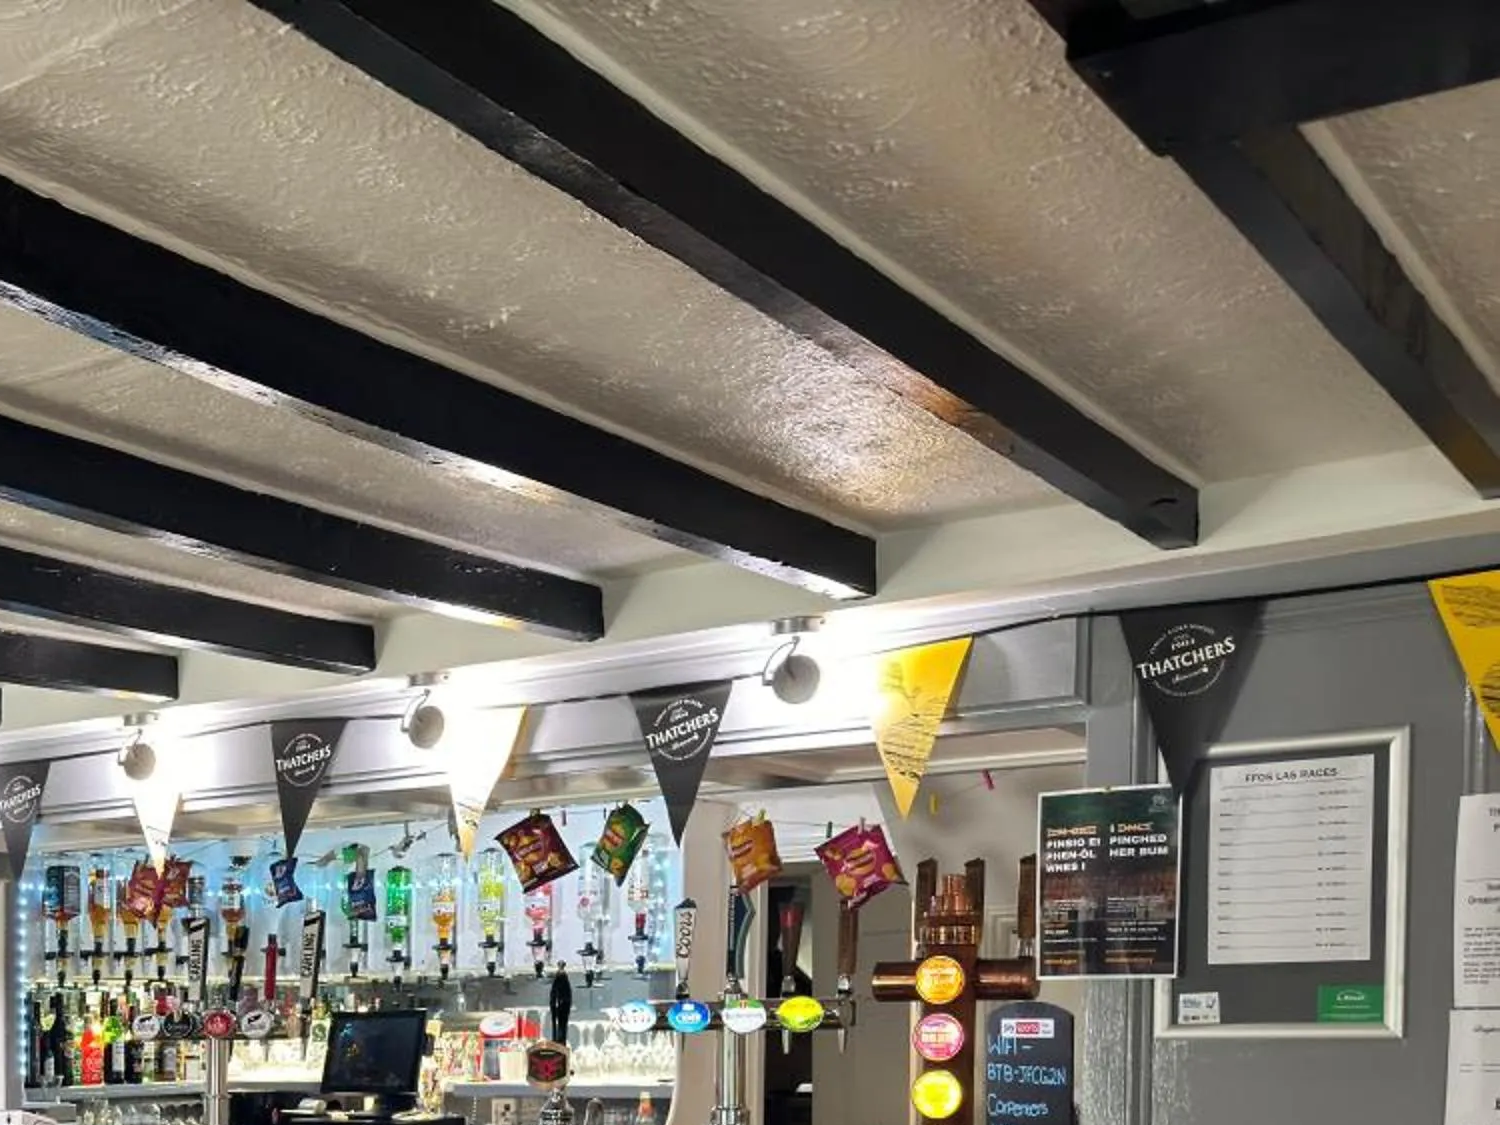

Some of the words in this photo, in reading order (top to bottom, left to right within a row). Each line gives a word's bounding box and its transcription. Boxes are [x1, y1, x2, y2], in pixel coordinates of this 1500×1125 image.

[1136, 636, 1236, 679] THATCHERS
[645, 707, 719, 749] THATCHERS
[276, 743, 331, 772] THATCHERS
[1245, 772, 1273, 783] FFOS
[1275, 771, 1297, 781] LAS
[1299, 767, 1338, 778] RACES
[1109, 834, 1168, 845] PINCHED
[1109, 847, 1135, 858] HER
[1139, 846, 1169, 857] BUM
[301, 933, 315, 977] CARLING
[676, 911, 693, 959] Coors
[189, 939, 202, 983] CARLING
